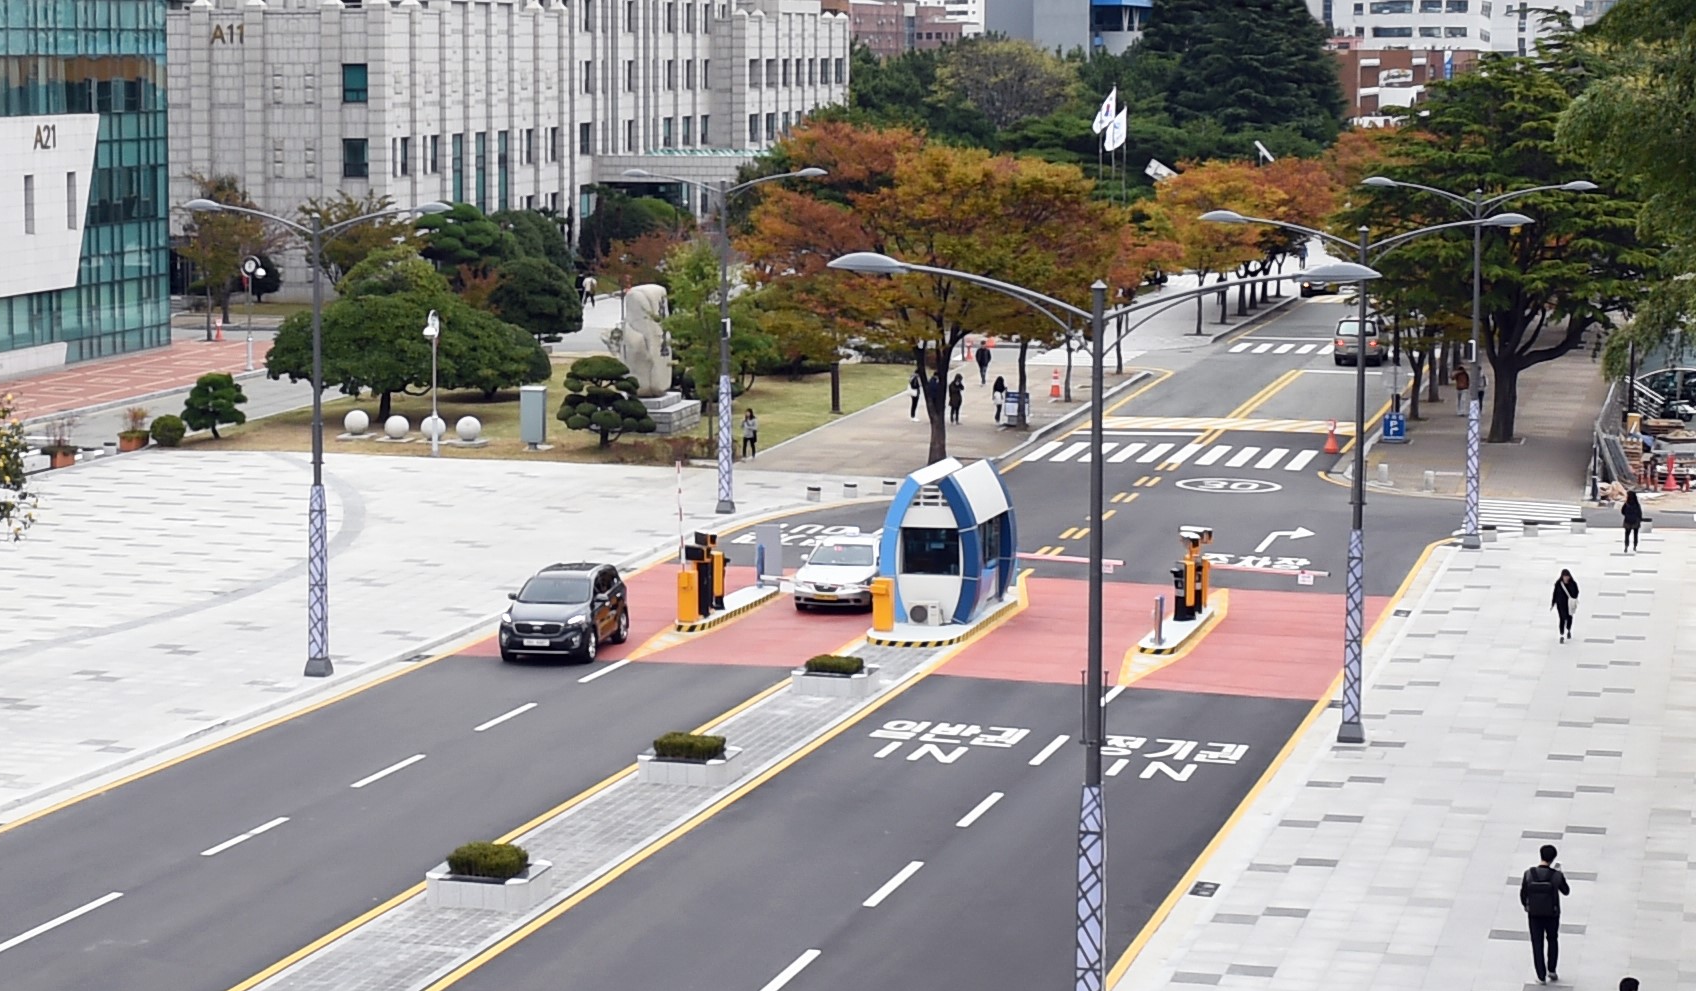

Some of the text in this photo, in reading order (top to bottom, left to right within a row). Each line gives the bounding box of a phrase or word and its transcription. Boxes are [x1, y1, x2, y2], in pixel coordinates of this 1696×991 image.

[210, 23, 244, 45] A11
[33, 124, 56, 150] A21
[1198, 480, 1260, 490] 30
[869, 720, 1031, 748] 일반권
[873, 741, 969, 763] IN
[1100, 735, 1250, 764] 정기권
[1105, 758, 1198, 782] IN
